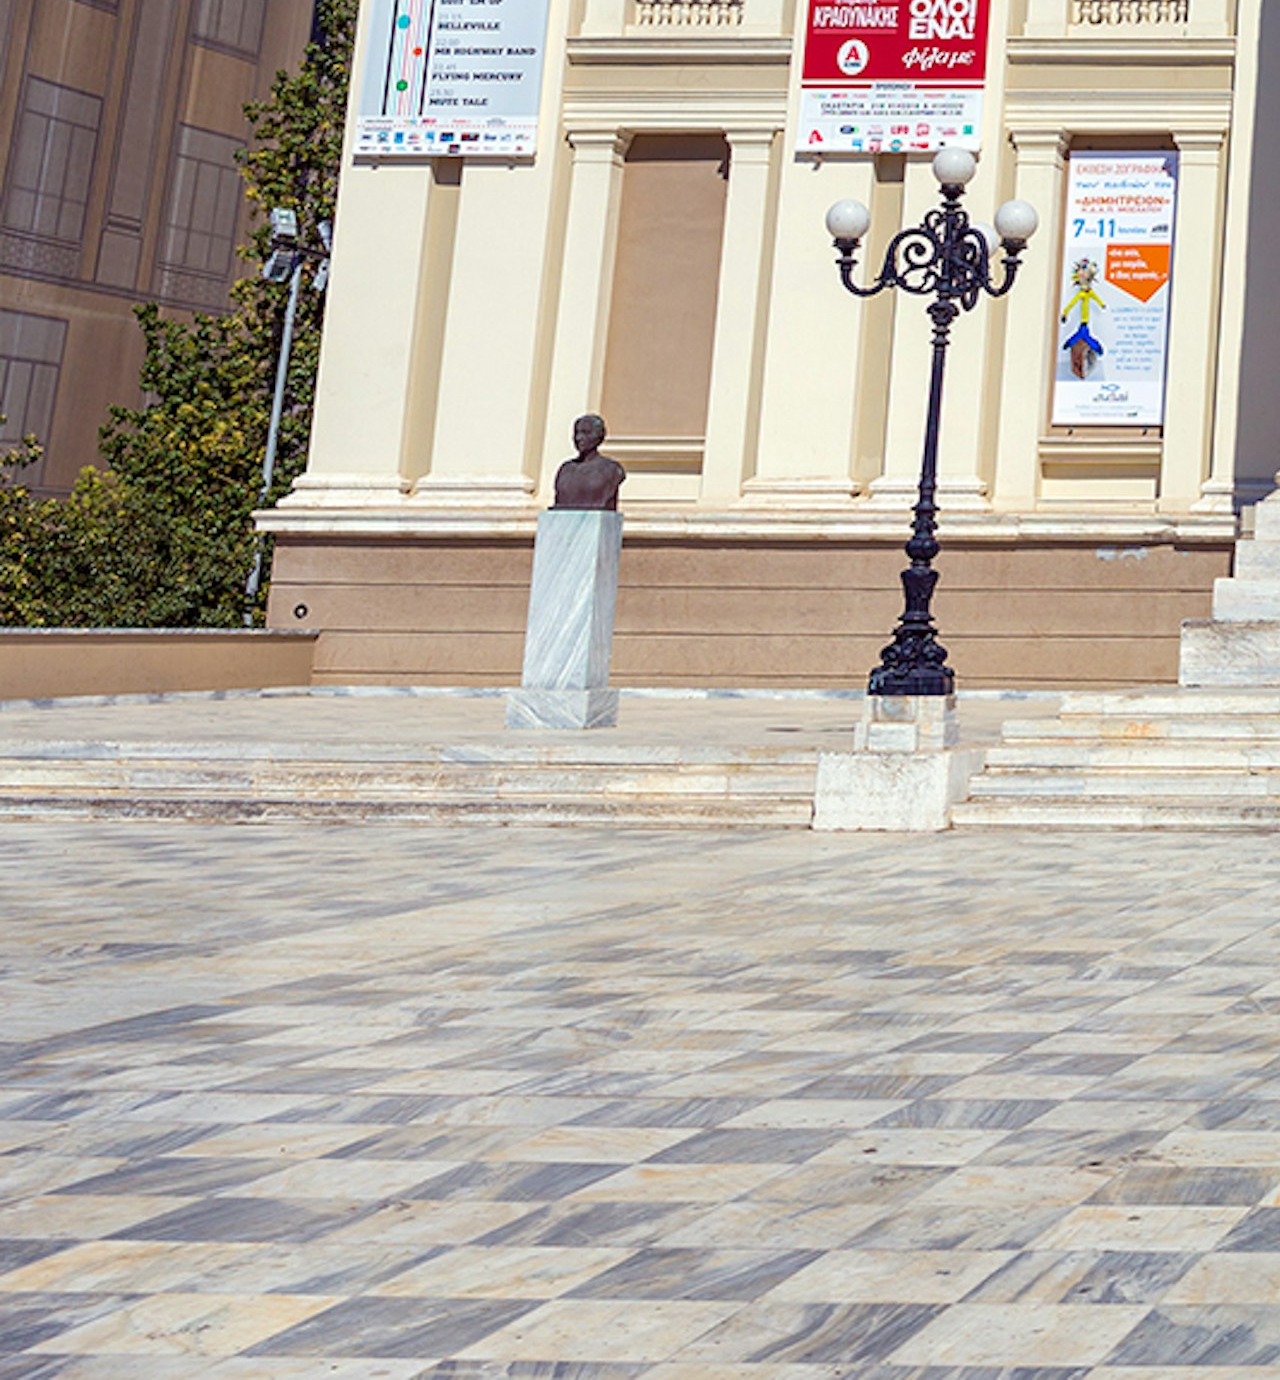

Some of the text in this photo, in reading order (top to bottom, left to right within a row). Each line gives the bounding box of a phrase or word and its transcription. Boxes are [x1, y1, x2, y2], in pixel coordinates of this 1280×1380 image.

[908, 18, 977, 40] ΕΝΑ!
[431, 72, 524, 81] FLYING MERCURY
[463, 98, 489, 106] TALE
[1073, 219, 1085, 238] 7
[1098, 219, 1115, 238] 11
